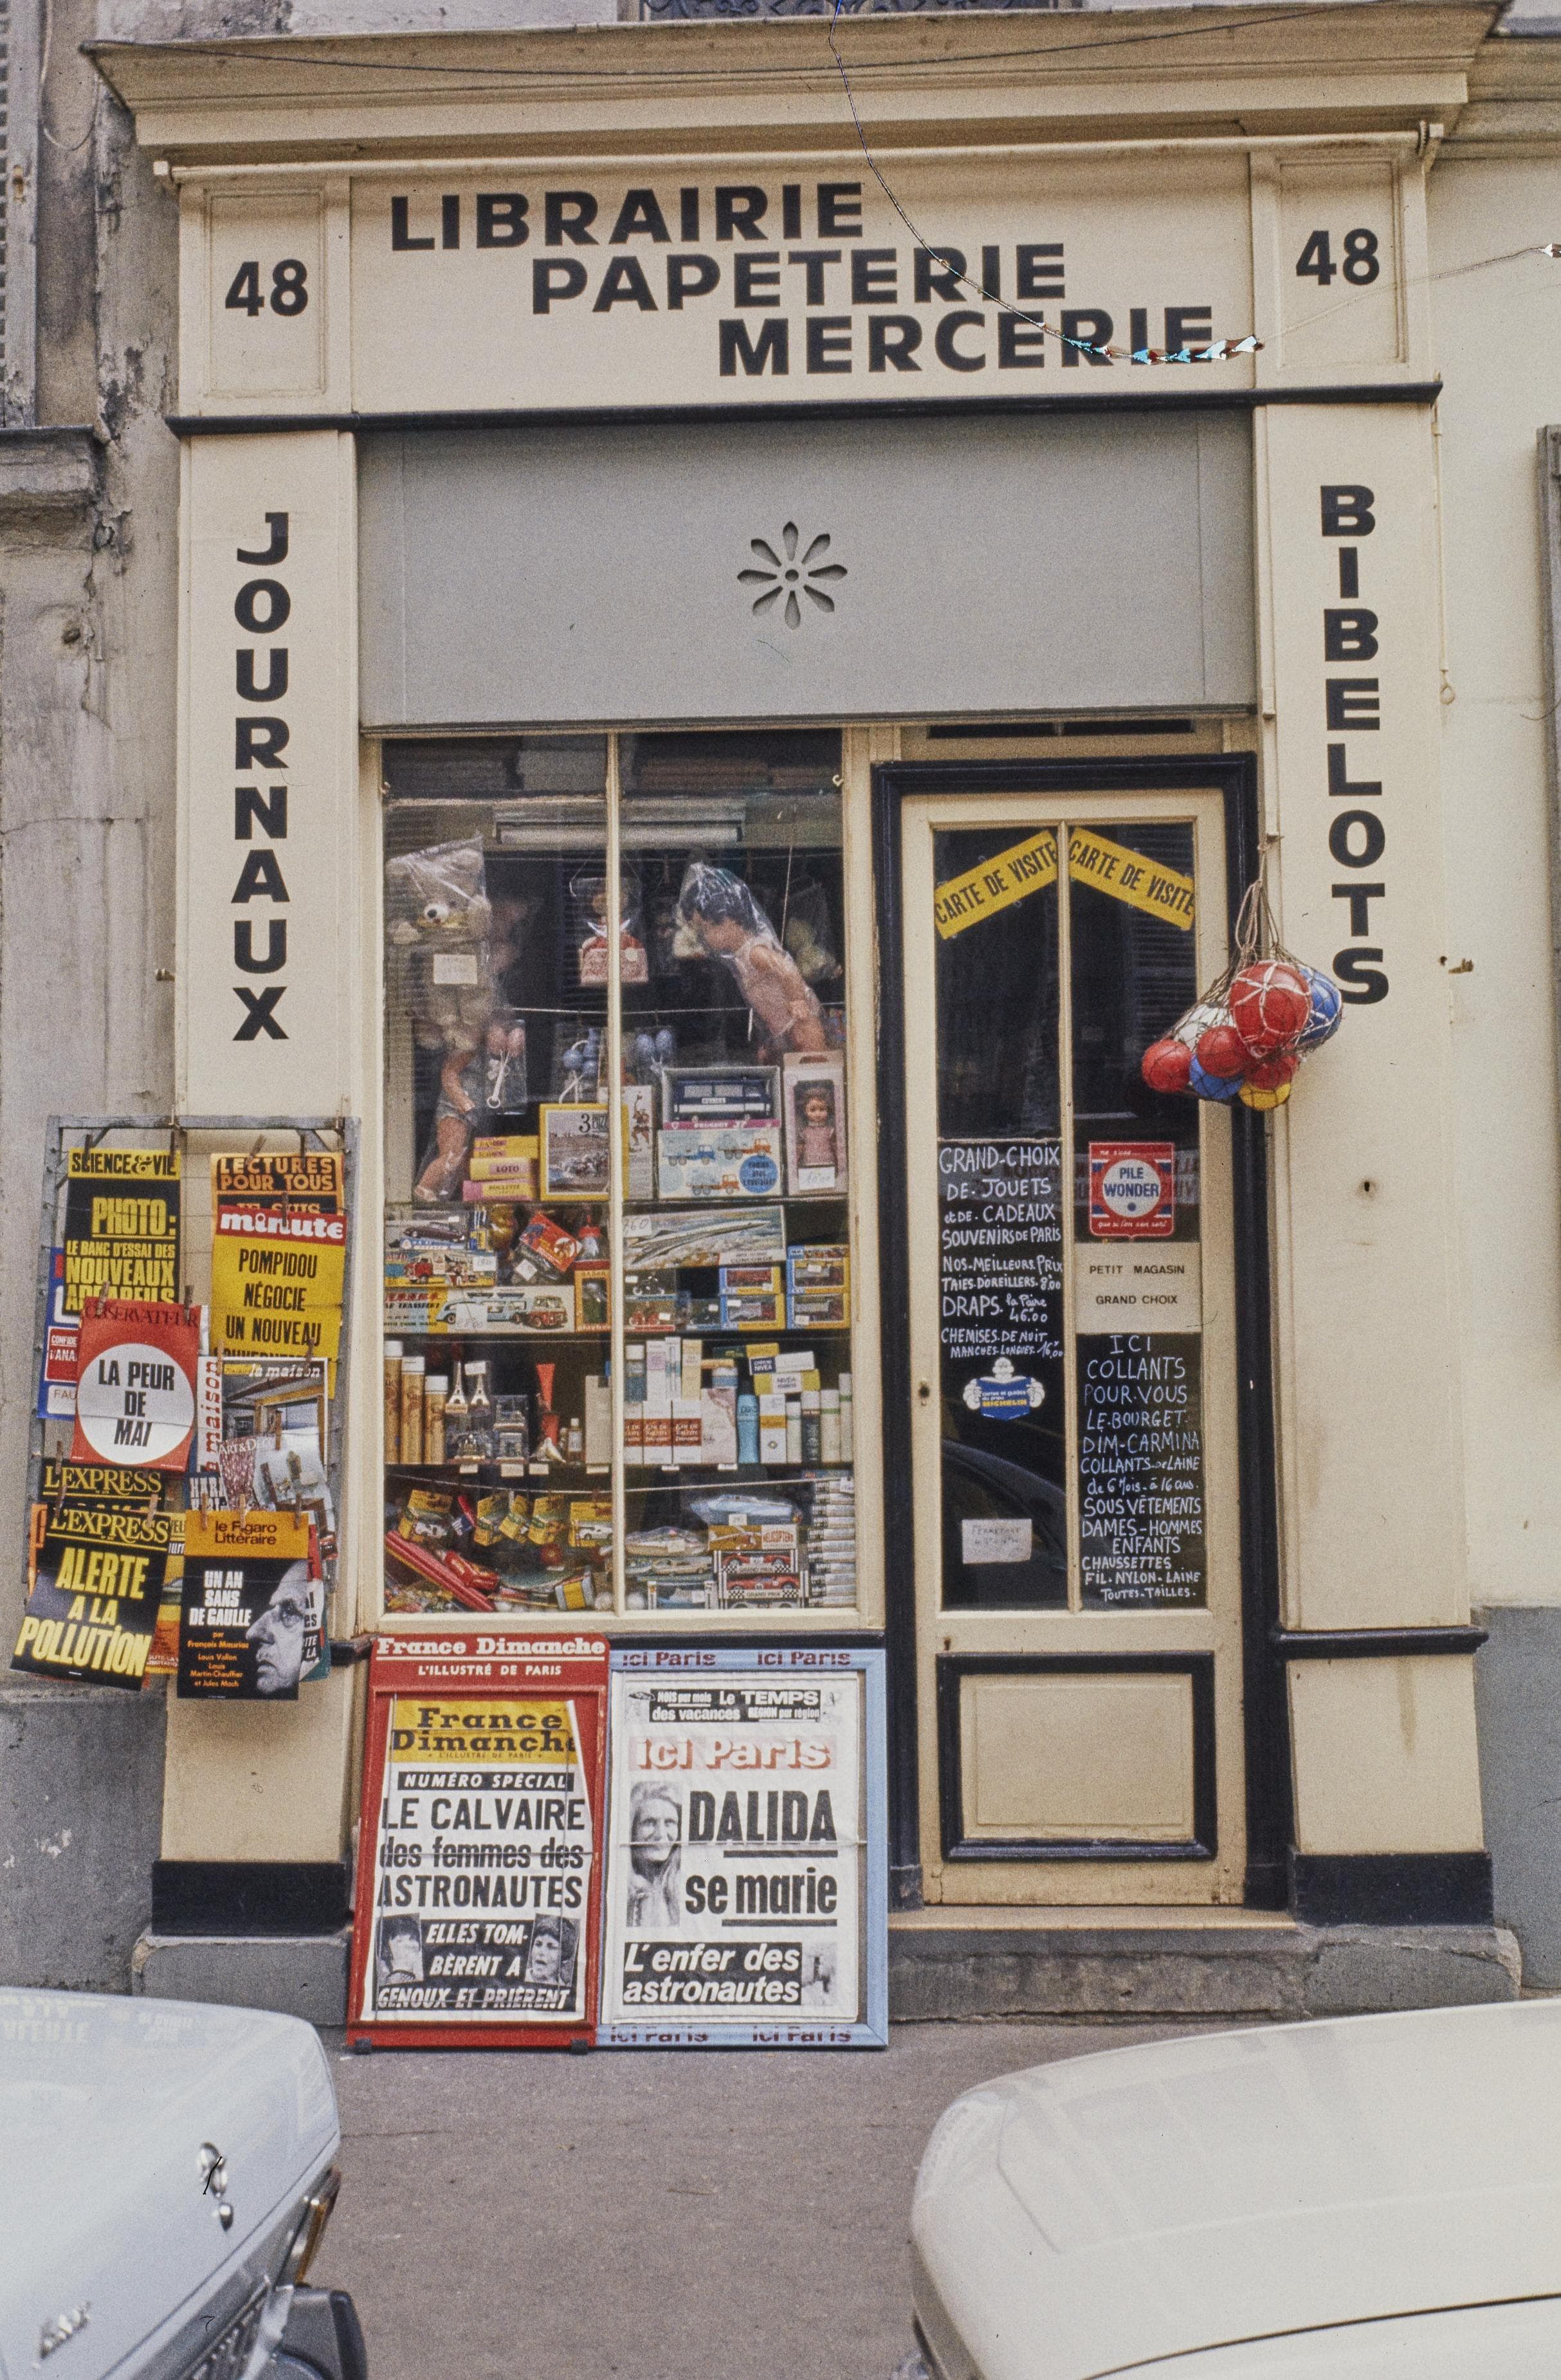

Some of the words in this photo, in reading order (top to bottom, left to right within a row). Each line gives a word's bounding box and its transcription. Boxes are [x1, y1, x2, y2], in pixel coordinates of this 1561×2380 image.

[389, 181, 862, 252] LIBRAIRIE
[1297, 229, 1380, 286] 48
[224, 261, 308, 318] 48
[533, 244, 1066, 315] PAPETERIE
[720, 307, 1212, 378] MERCERIE
[1320, 484, 1389, 1005] BIBELOTS
[231, 512, 291, 1041] JOURNAUX
[935, 882, 985, 924] CARTE
[983, 870, 1009, 896] DE
[1008, 842, 1058, 883] VISITE
[1069, 839, 1119, 880] CARTE
[1120, 864, 1144, 891] DE
[1148, 875, 1194, 915] VISITE
[72, 1153, 131, 1173] SCIENCE
[153, 1153, 176, 1176] VIE
[221, 1158, 333, 1175] LECTURES
[1119, 1167, 1144, 1179] PILE
[221, 1175, 273, 1191] POUR
[285, 1175, 334, 1191] TOUS
[981, 1178, 1051, 1198] JOUETS
[1104, 1184, 1160, 1197] WONDER
[92, 1198, 176, 1235] PHOTO:
[983, 1204, 1055, 1223] CADEAUX
[221, 1213, 343, 1239] minute
[942, 1225, 1014, 1250] SOUVENIRS
[1030, 1223, 1061, 1243] PARIS
[66, 1241, 77, 1254] LE
[79, 1243, 109, 1256] BANC
[113, 1244, 152, 1258] D'ESSAI
[155, 1245, 175, 1259] DES
[66, 1258, 174, 1286] NOUVEAUX
[239, 1249, 317, 1277] POMPIDOU
[1090, 1265, 1123, 1274] PETIT
[1133, 1265, 1185, 1274] MAGASIN
[244, 1281, 307, 1311] NÉGOCIE
[1096, 1295, 1137, 1304] GRAND
[1142, 1295, 1178, 1304] CHOIX
[226, 1316, 246, 1339] UN
[252, 1317, 321, 1346] NOUVEAU
[1001, 1332, 1018, 1342] DE
[1019, 1328, 1048, 1342] NUIT
[1109, 1335, 1151, 1354] ICI
[99, 1360, 120, 1386] LA
[129, 1362, 174, 1391] PEUR
[1088, 1357, 1185, 1380] COLLANTS
[124, 1391, 146, 1417] DE
[1138, 1385, 1187, 1404] VOUS
[114, 1419, 152, 1447] MAI
[1167, 1456, 1200, 1470] LAINE
[44, 1466, 161, 1497] L'EXPRESS
[1088, 1479, 1104, 1494] de
[1107, 1479, 1115, 1492] 6
[1160, 1478, 1172, 1490] 16
[1084, 1497, 1125, 1517] SOUS
[50, 1508, 170, 1544] L'EXPRESS
[215, 1521, 228, 1531] le
[232, 1521, 277, 1533] Figaro
[215, 1533, 276, 1544] Littéraire
[1112, 1537, 1181, 1555] ENFANTS
[55, 1548, 149, 1600] ALERTE
[1082, 1557, 1171, 1571] CHAUSSETTES
[1166, 1566, 1201, 1583] LAINE
[205, 1571, 223, 1589] UN
[225, 1571, 242, 1589] AN
[205, 1590, 240, 1607] SANS
[68, 1599, 87, 1620] A
[89, 1600, 116, 1624] LA
[189, 1608, 205, 1625] DE
[207, 1609, 251, 1626] GAULLE
[14, 1616, 153, 1678] POLLUTION
[377, 1637, 466, 1655] France
[477, 1637, 605, 1655] Dimanche
[418, 1663, 491, 1676] L'ILLUSTRÉ
[500, 1664, 516, 1676] DE
[525, 1664, 561, 1675] PARIS
[622, 1651, 648, 1667] ici
[655, 1651, 716, 1667] Paris
[757, 1651, 783, 1666] ici
[790, 1651, 851, 1666] Paris
[719, 1691, 735, 1705] Le
[740, 1690, 818, 1705] TEMPS
[417, 1707, 562, 1730] France
[652, 1707, 675, 1721] des
[679, 1708, 740, 1721] vacances
[392, 1730, 576, 1752] Dimanche
[635, 1738, 693, 1770] ici
[707, 1738, 831, 1770] Paris
[405, 1771, 482, 1788] NUMÉRO
[493, 1771, 569, 1790] SPÉCIAL
[382, 1799, 419, 1830] LE
[432, 1799, 585, 1831] CALVAIRE
[688, 1790, 837, 1843] DALIDA
[379, 1836, 422, 1868] des
[433, 1836, 531, 1869] femmes
[540, 1836, 583, 1869] des
[378, 1874, 581, 1909] ASTRONAUTES
[686, 1875, 728, 1915] se
[736, 1867, 837, 1915] marie
[426, 1923, 477, 1945] ELLES
[483, 1923, 528, 1945] TOM-
[625, 1944, 735, 1972] L'enfer
[744, 1942, 799, 1972] des
[377, 1987, 448, 2009] GENOUX
[456, 1989, 477, 2009] ET
[624, 1979, 800, 2003] astronautes
